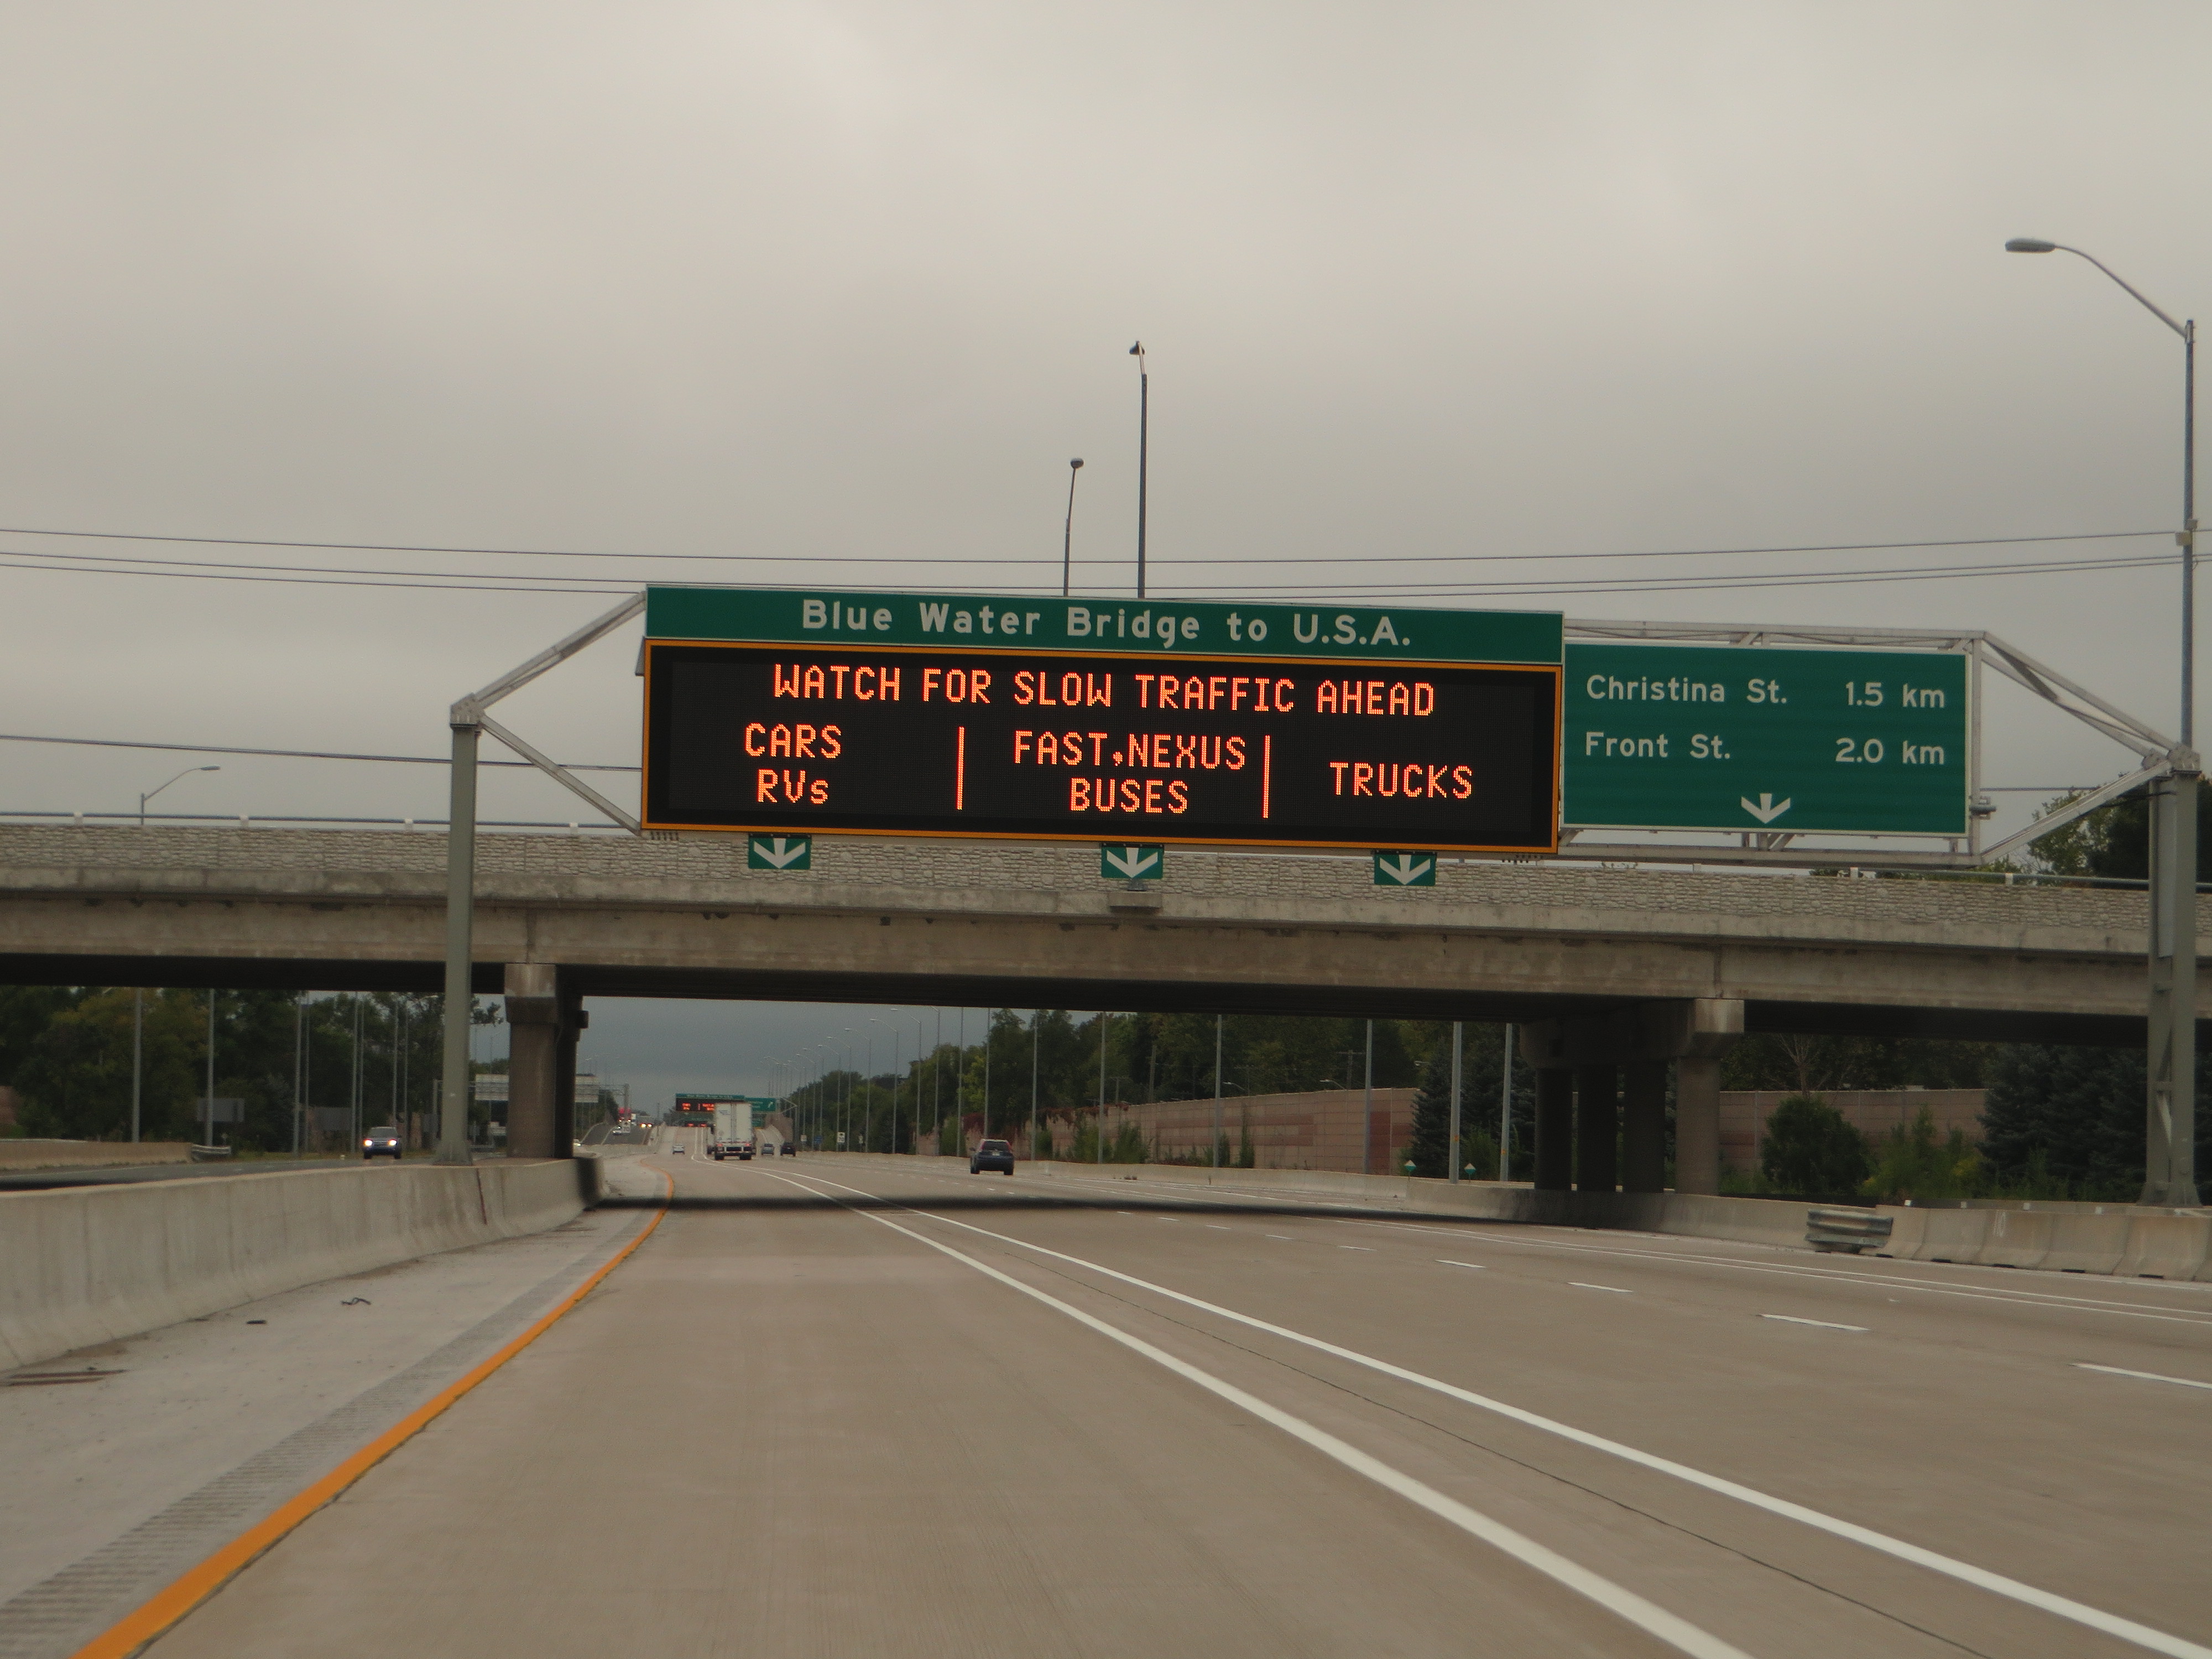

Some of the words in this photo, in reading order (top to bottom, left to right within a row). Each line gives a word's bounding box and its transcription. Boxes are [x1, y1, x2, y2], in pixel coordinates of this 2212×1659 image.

[803, 599, 892, 630] Blue
[920, 602, 1040, 634] Water
[1066, 607, 1199, 649] Bridge
[1227, 613, 1267, 641] to
[1293, 614, 1410, 645] U.S.A.
[774, 664, 900, 701] WATCH
[922, 668, 991, 704] FOR
[1014, 671, 1112, 707] SLOW
[1135, 674, 1294, 712] TRAFFIC
[1317, 680, 1434, 716] AHEAD
[1586, 674, 1725, 702] Christina
[1746, 678, 1787, 703] St.
[1845, 681, 1884, 706] 1.5
[1902, 684, 1945, 708] km
[744, 723, 842, 759] CARS
[1585, 731, 1668, 758] Front
[1689, 733, 1730, 759] St.
[1835, 737, 1884, 763] 2.0
[1902, 740, 1944, 765] km
[757, 769, 828, 804] RVs
[1070, 778, 1188, 814] BUSES
[1329, 761, 1472, 799] TRUCKS
